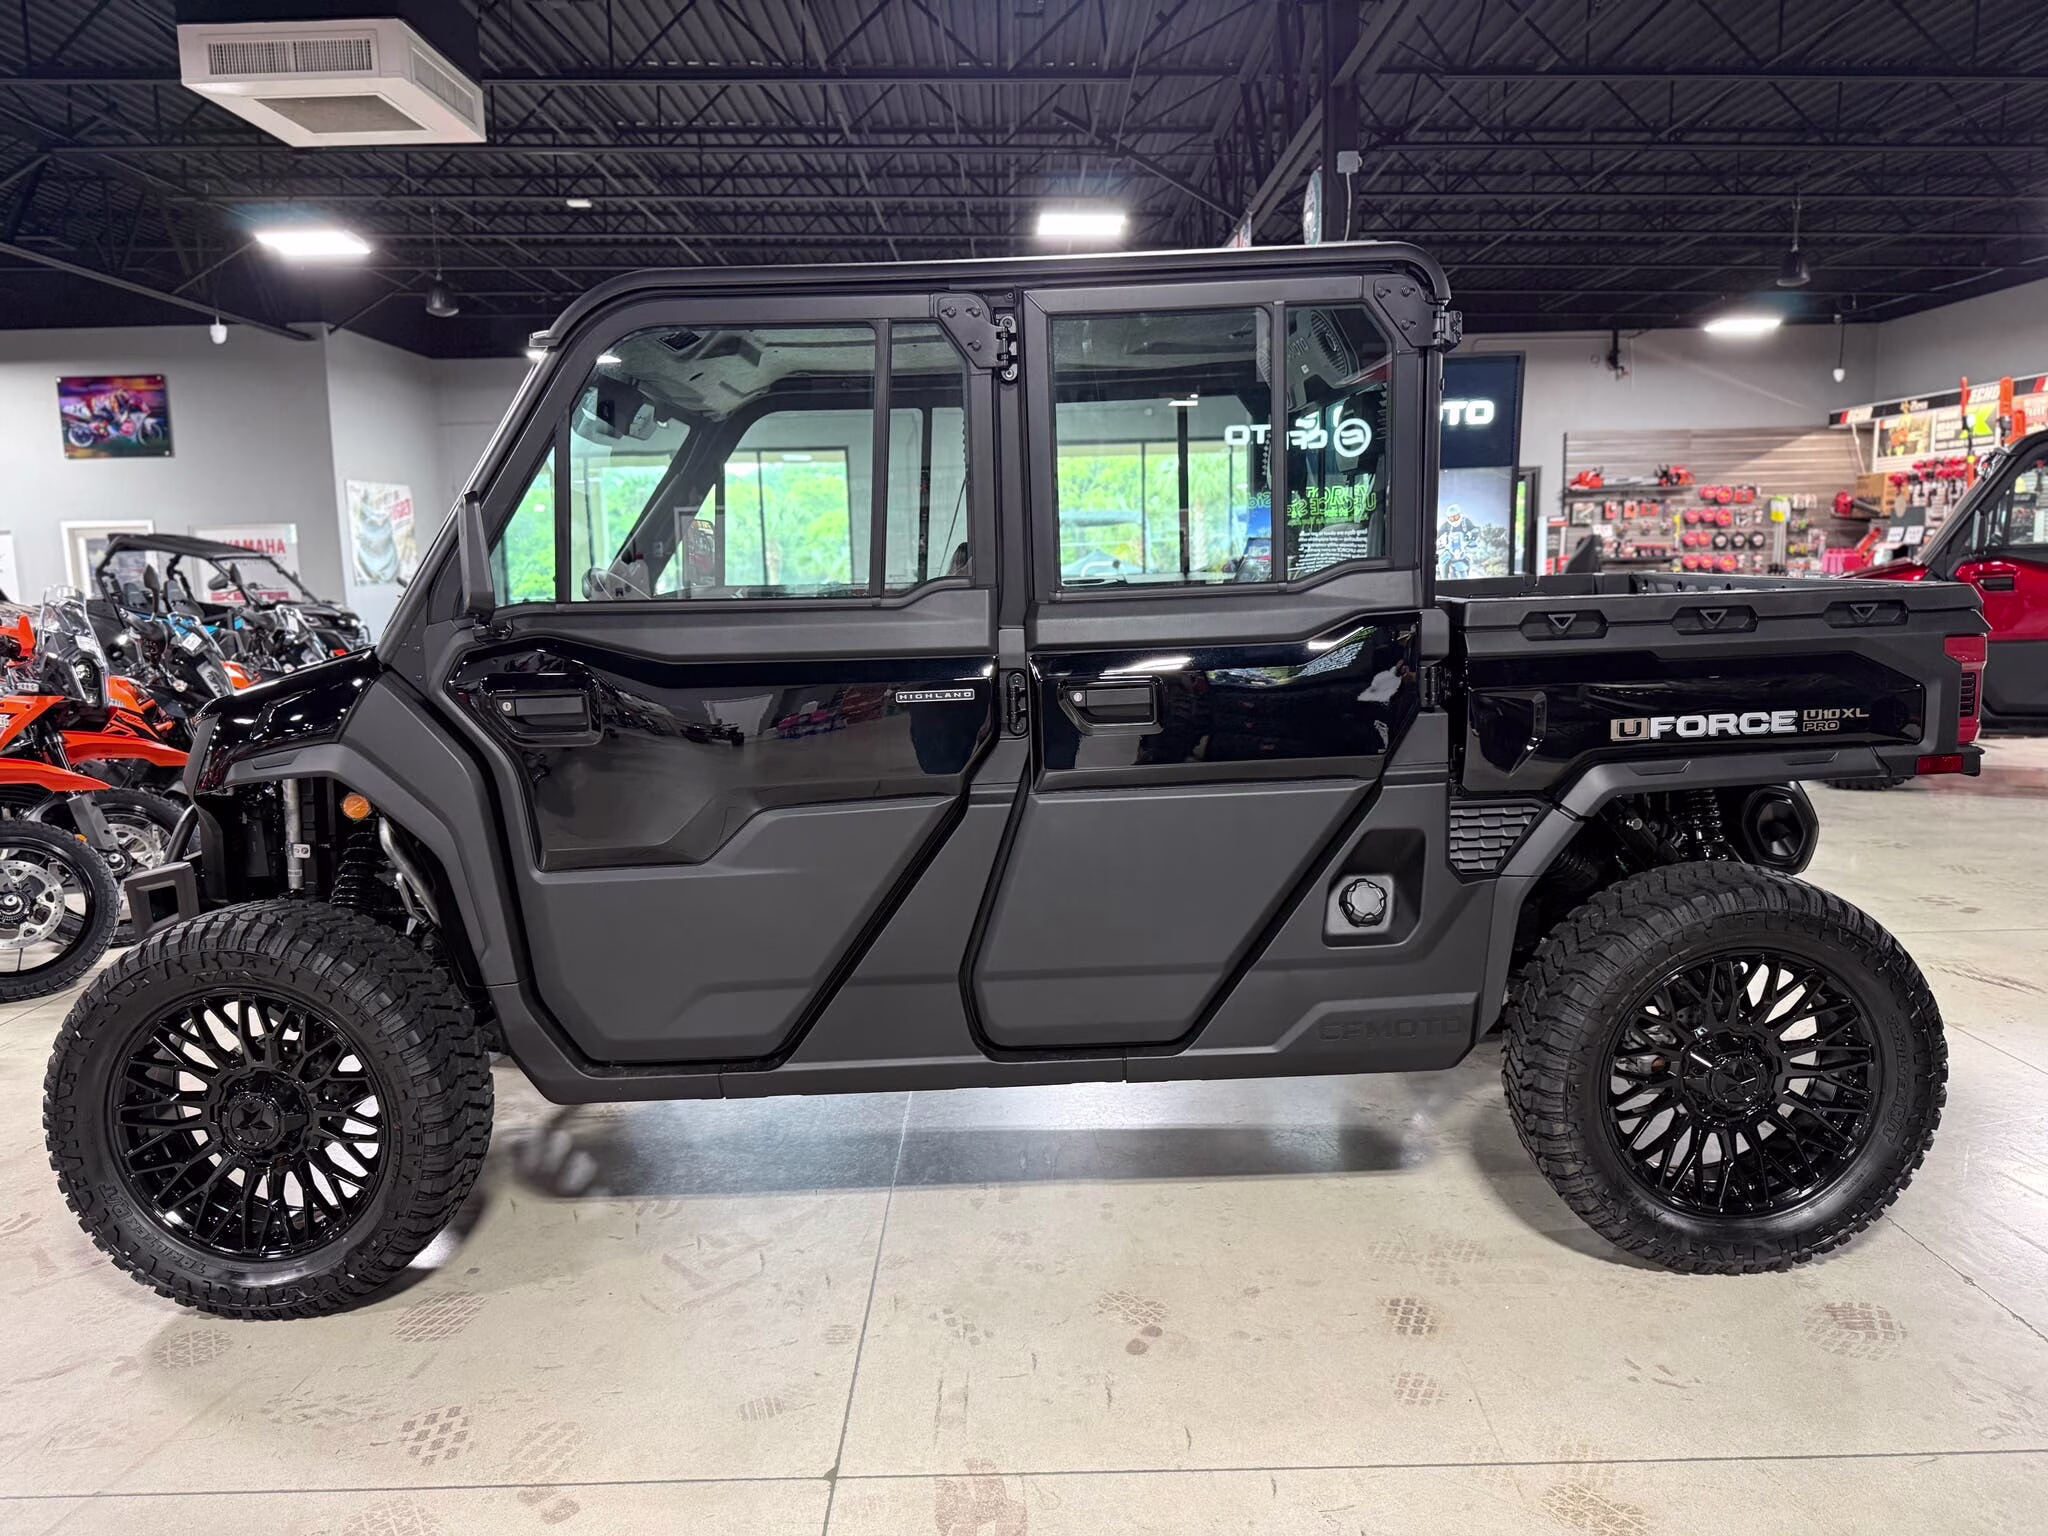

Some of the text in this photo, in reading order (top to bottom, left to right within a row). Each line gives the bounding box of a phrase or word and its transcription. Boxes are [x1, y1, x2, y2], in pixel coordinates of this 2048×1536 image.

[1440, 400, 1495, 426] TO
[899, 692, 972, 700] HIGHLAND
[1610, 710, 1799, 742] UFORCE
[1803, 720, 1840, 732] PRO
